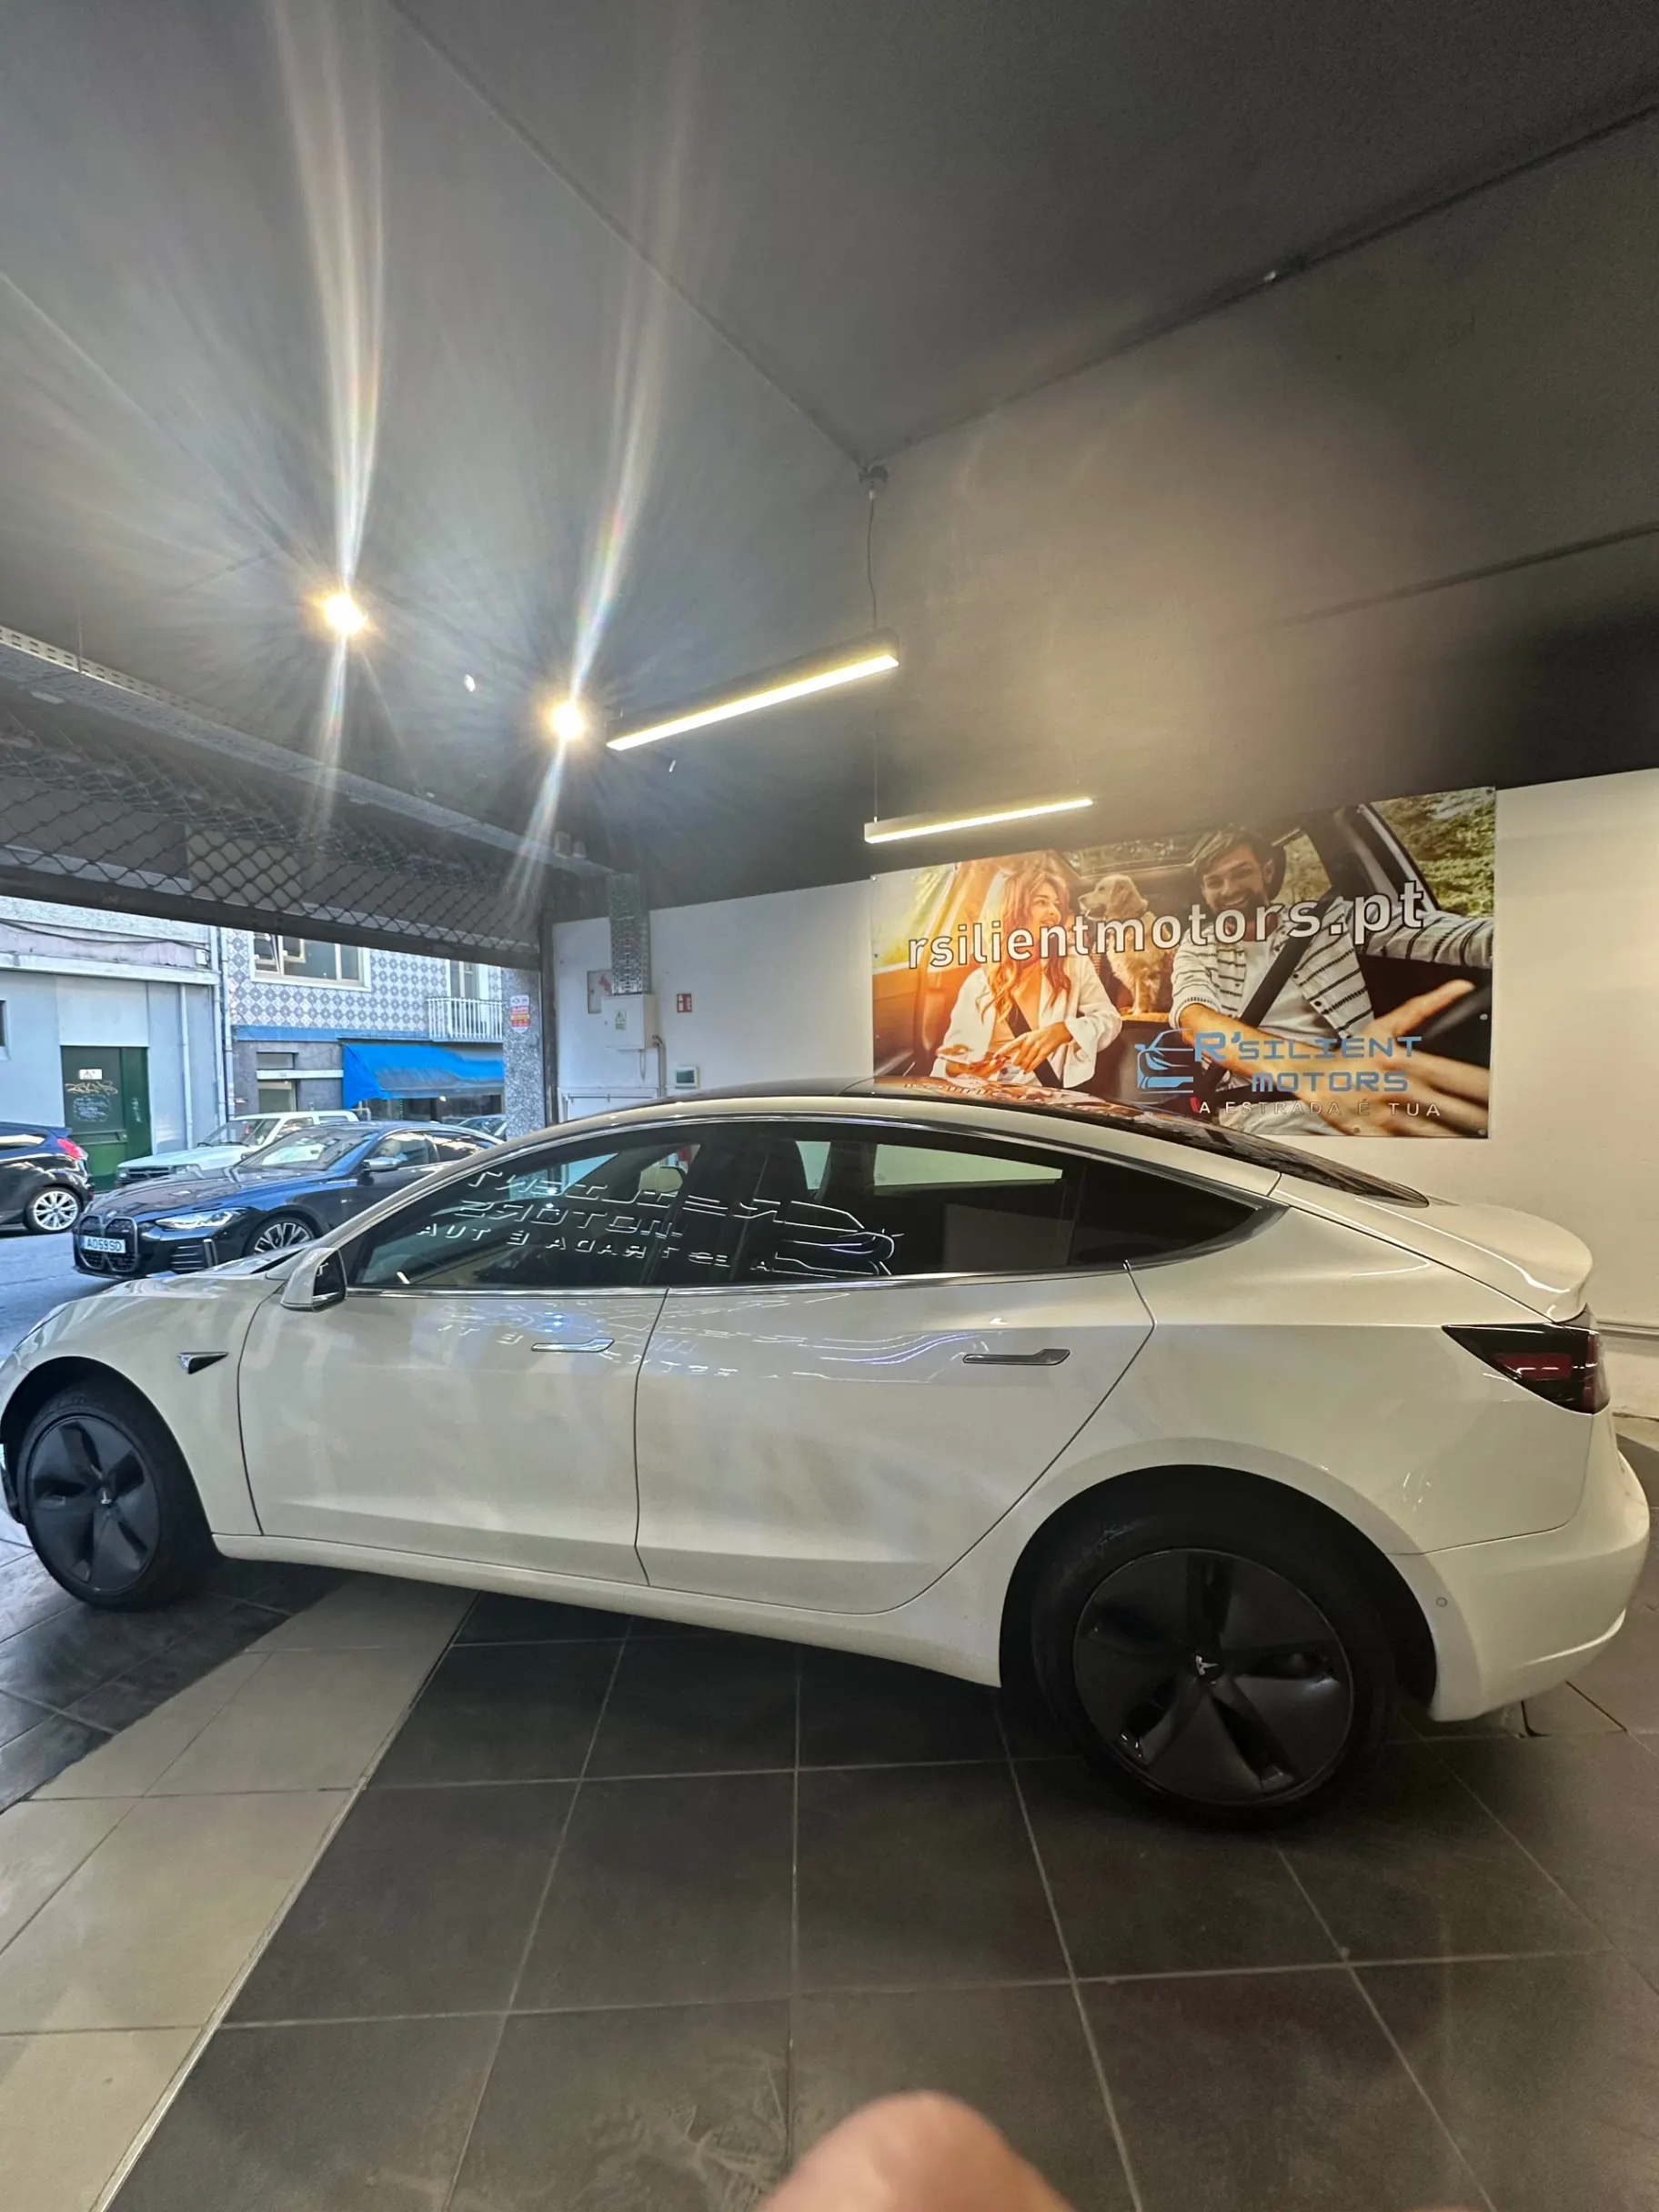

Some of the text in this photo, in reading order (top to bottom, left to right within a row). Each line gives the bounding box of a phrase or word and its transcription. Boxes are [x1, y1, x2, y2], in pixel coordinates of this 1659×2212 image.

[908, 880, 1424, 970] rsilientmotors.pt
[1194, 1031, 1423, 1062] R'SILIENT
[1251, 1071, 1409, 1092] MOTORS
[1198, 1098, 1442, 1117] A ESTRADA É TUA
